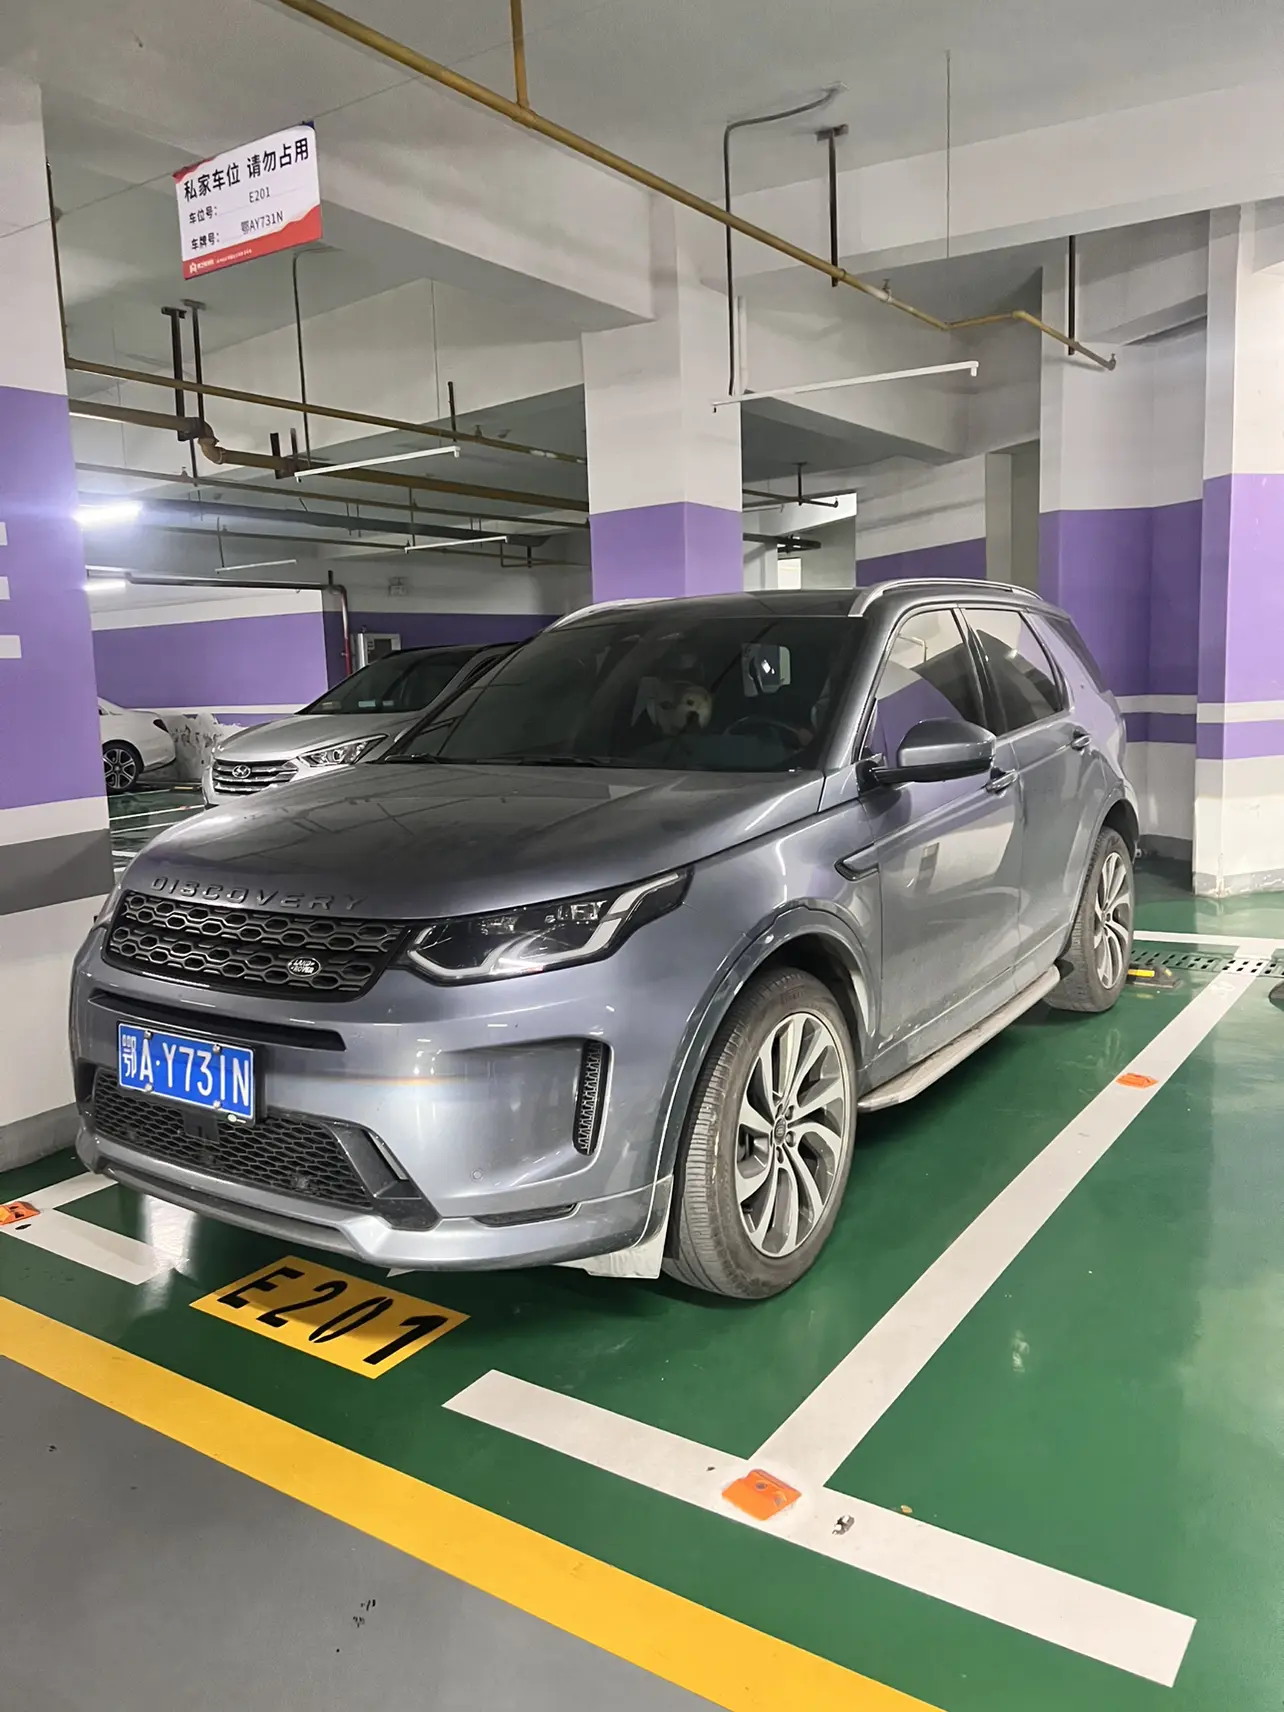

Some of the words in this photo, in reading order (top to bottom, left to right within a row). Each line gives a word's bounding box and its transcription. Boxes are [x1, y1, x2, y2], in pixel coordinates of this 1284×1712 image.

[183, 162, 241, 202] 私家车位
[246, 137, 309, 179] 请勿占用
[248, 186, 271, 203] E201
[240, 210, 284, 235] 鄂AY731N
[151, 876, 367, 911] DISCOVERY
[217, 1266, 449, 1365] E201
